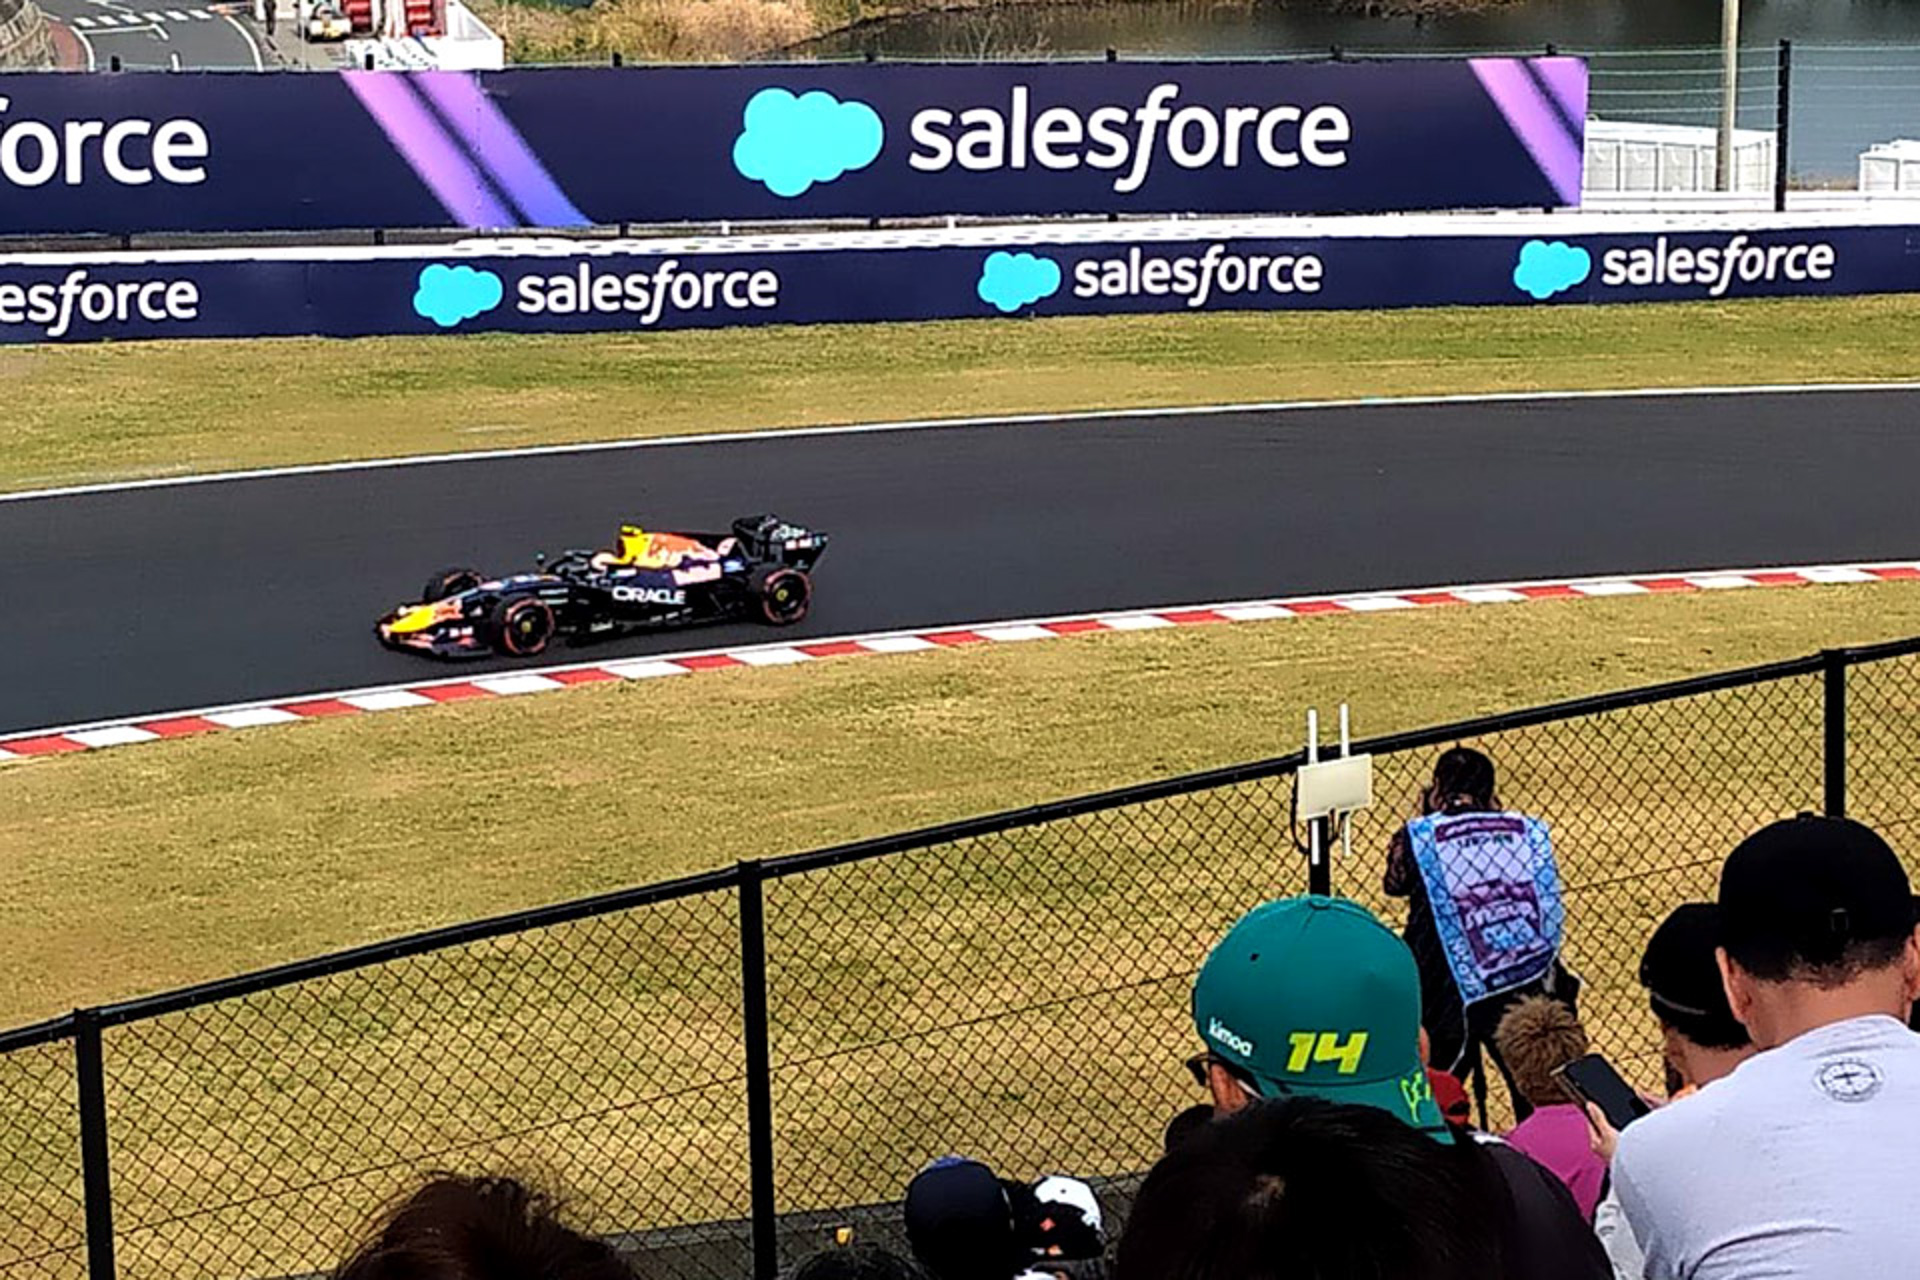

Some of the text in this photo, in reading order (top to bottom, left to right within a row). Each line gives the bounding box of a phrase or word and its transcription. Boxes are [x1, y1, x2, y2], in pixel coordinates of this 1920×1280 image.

[0, 97, 208, 186] orce
[909, 84, 1350, 191] salesforce
[517, 259, 778, 325] salesforce
[1074, 244, 1323, 307] salesforce
[1602, 236, 1835, 295] salesforce
[0, 270, 199, 337] esforce
[612, 585, 686, 605] ORACLE
[1286, 1032, 1369, 1074] 14
